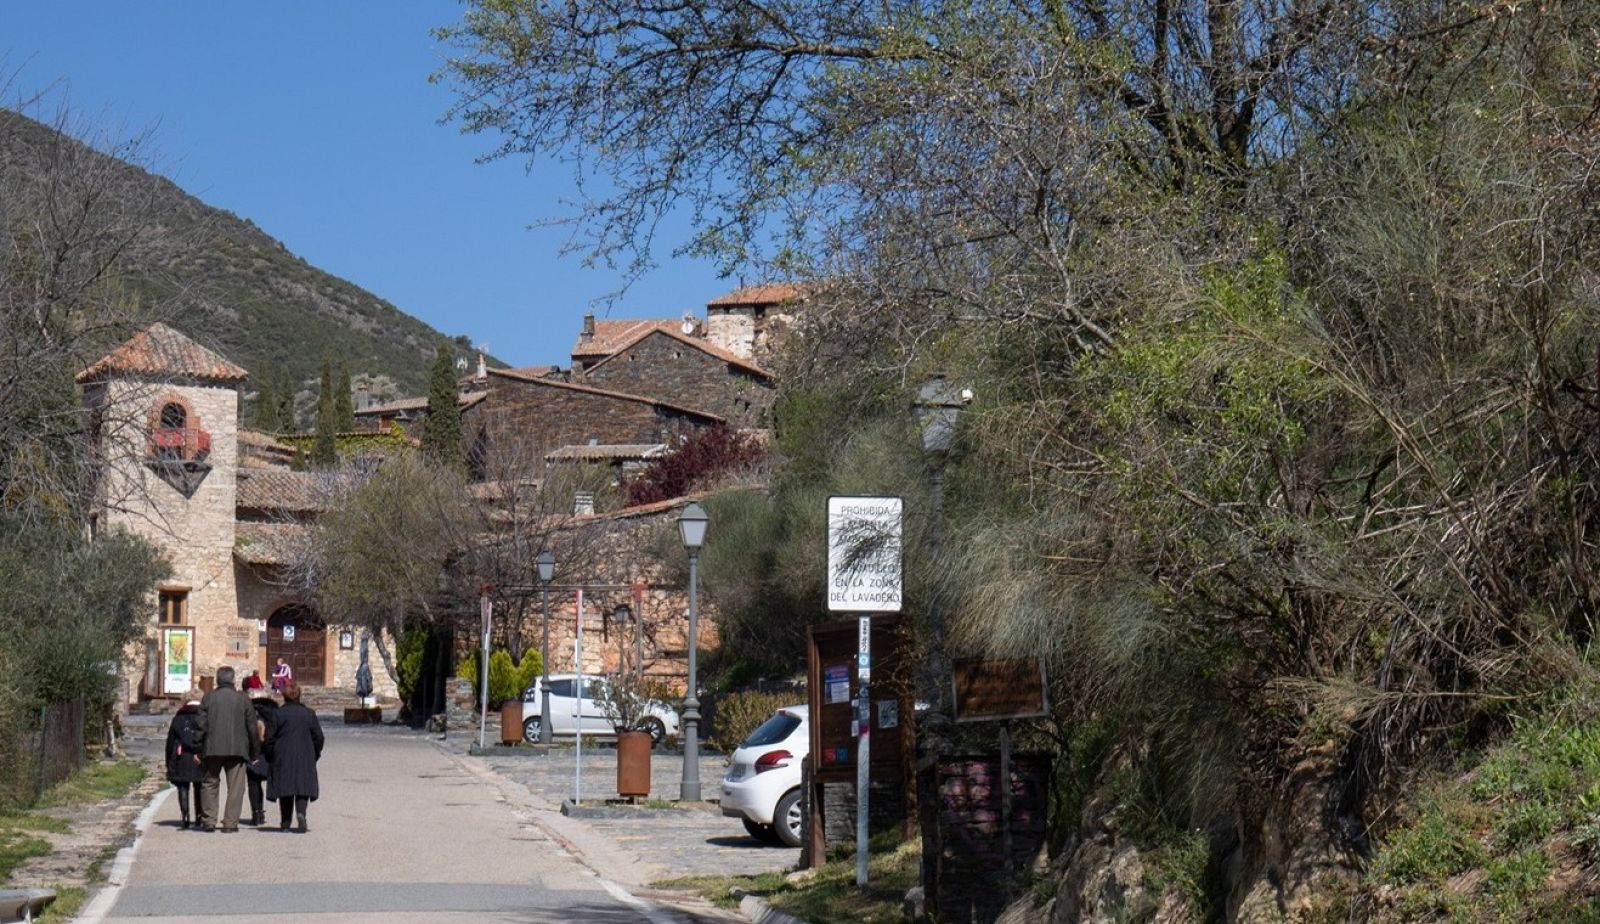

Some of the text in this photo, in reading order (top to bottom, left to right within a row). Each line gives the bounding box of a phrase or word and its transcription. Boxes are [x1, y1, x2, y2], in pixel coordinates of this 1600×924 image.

[852, 578, 865, 588] LA
[830, 592, 901, 602] DEL LAVADERO
